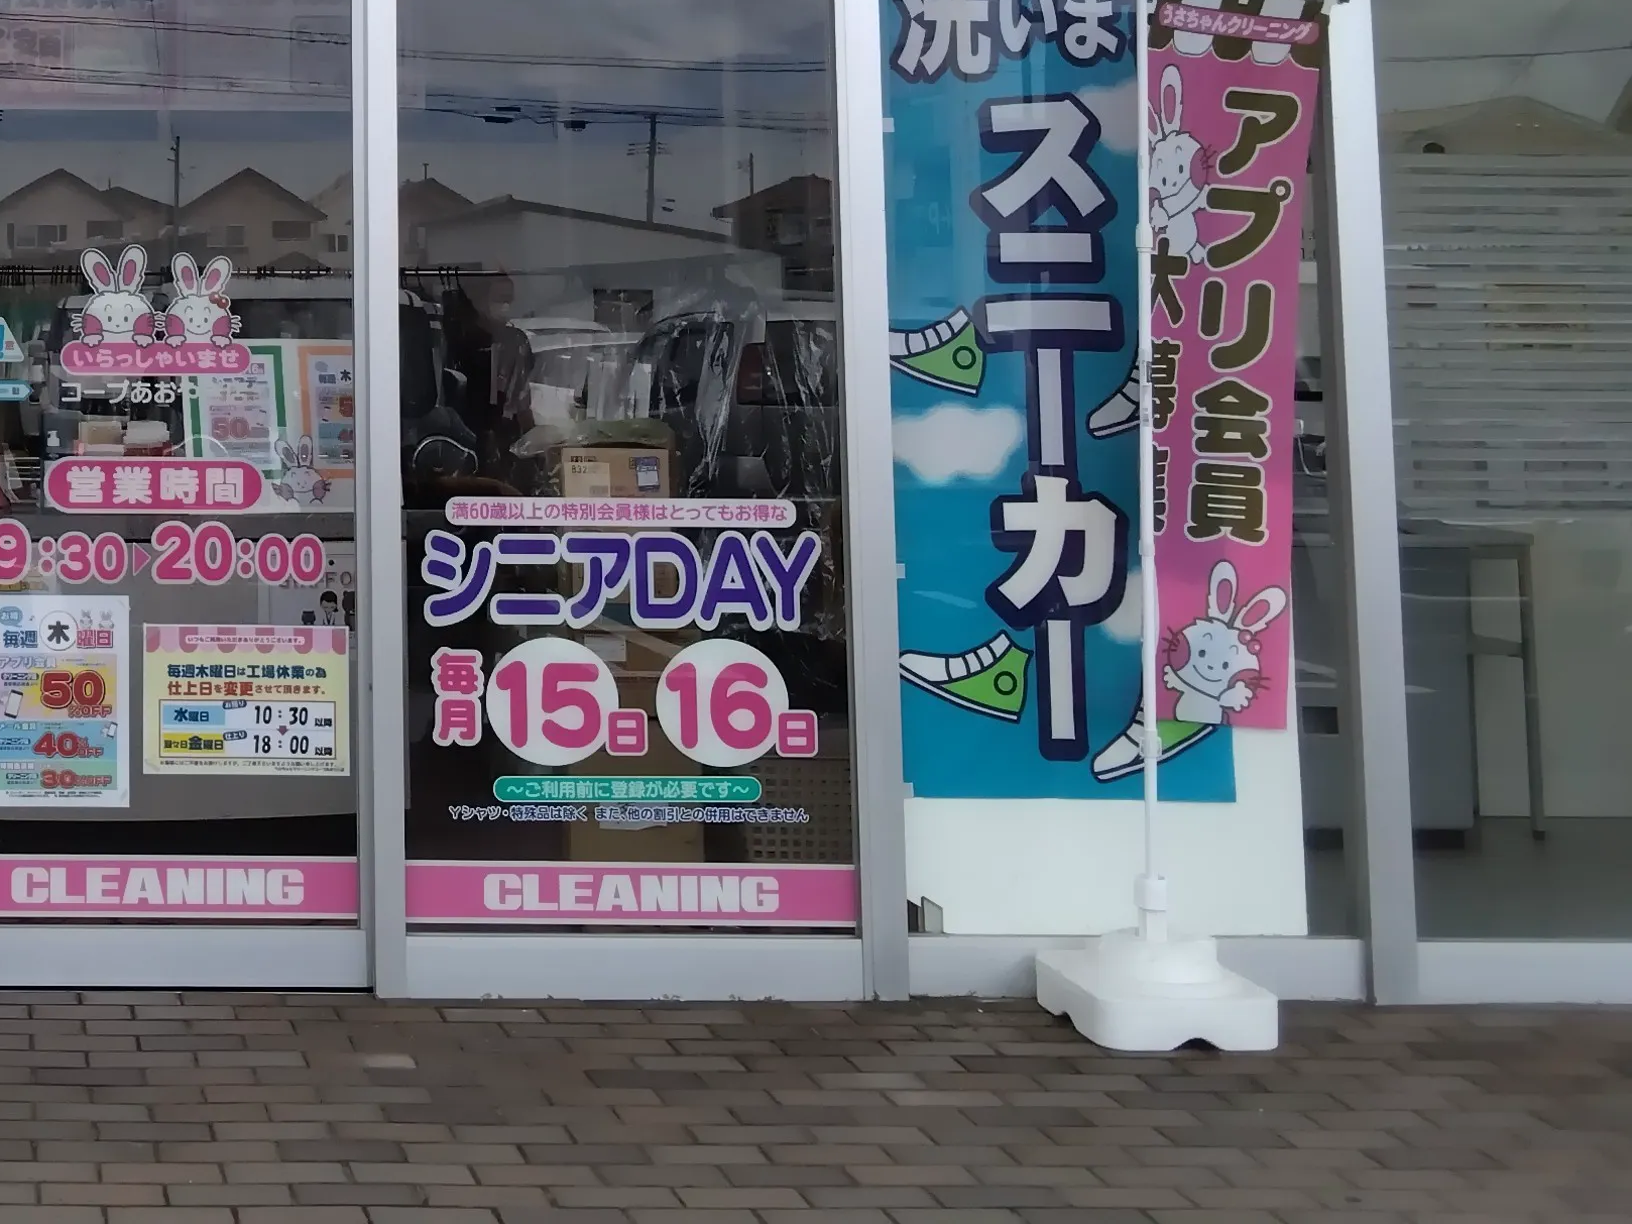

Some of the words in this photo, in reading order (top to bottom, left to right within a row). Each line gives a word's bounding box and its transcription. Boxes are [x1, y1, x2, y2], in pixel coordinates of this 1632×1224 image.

[1163, 3, 1313, 41] うさちゃんクリーニング
[1184, 87, 1303, 545] アプリ会員
[73, 347, 239, 369] いらっしゃいませ
[980, 98, 1118, 742] スニーカー
[66, 466, 244, 506] 営業時間
[451, 502, 788, 522] 満60歳以上の特別会員様はとってもお得な
[151, 521, 325, 585] 20:00
[424, 532, 819, 626] シニアDAY
[167, 664, 327, 679] 毎週木曜日は工場休業の為
[168, 681, 326, 696] 仕上日を変更させて頂きます。
[174, 708, 209, 722] 水曜日
[432, 648, 483, 745] 毎月
[11, 867, 305, 906] CLEANING
[484, 874, 779, 913] CLEANING
